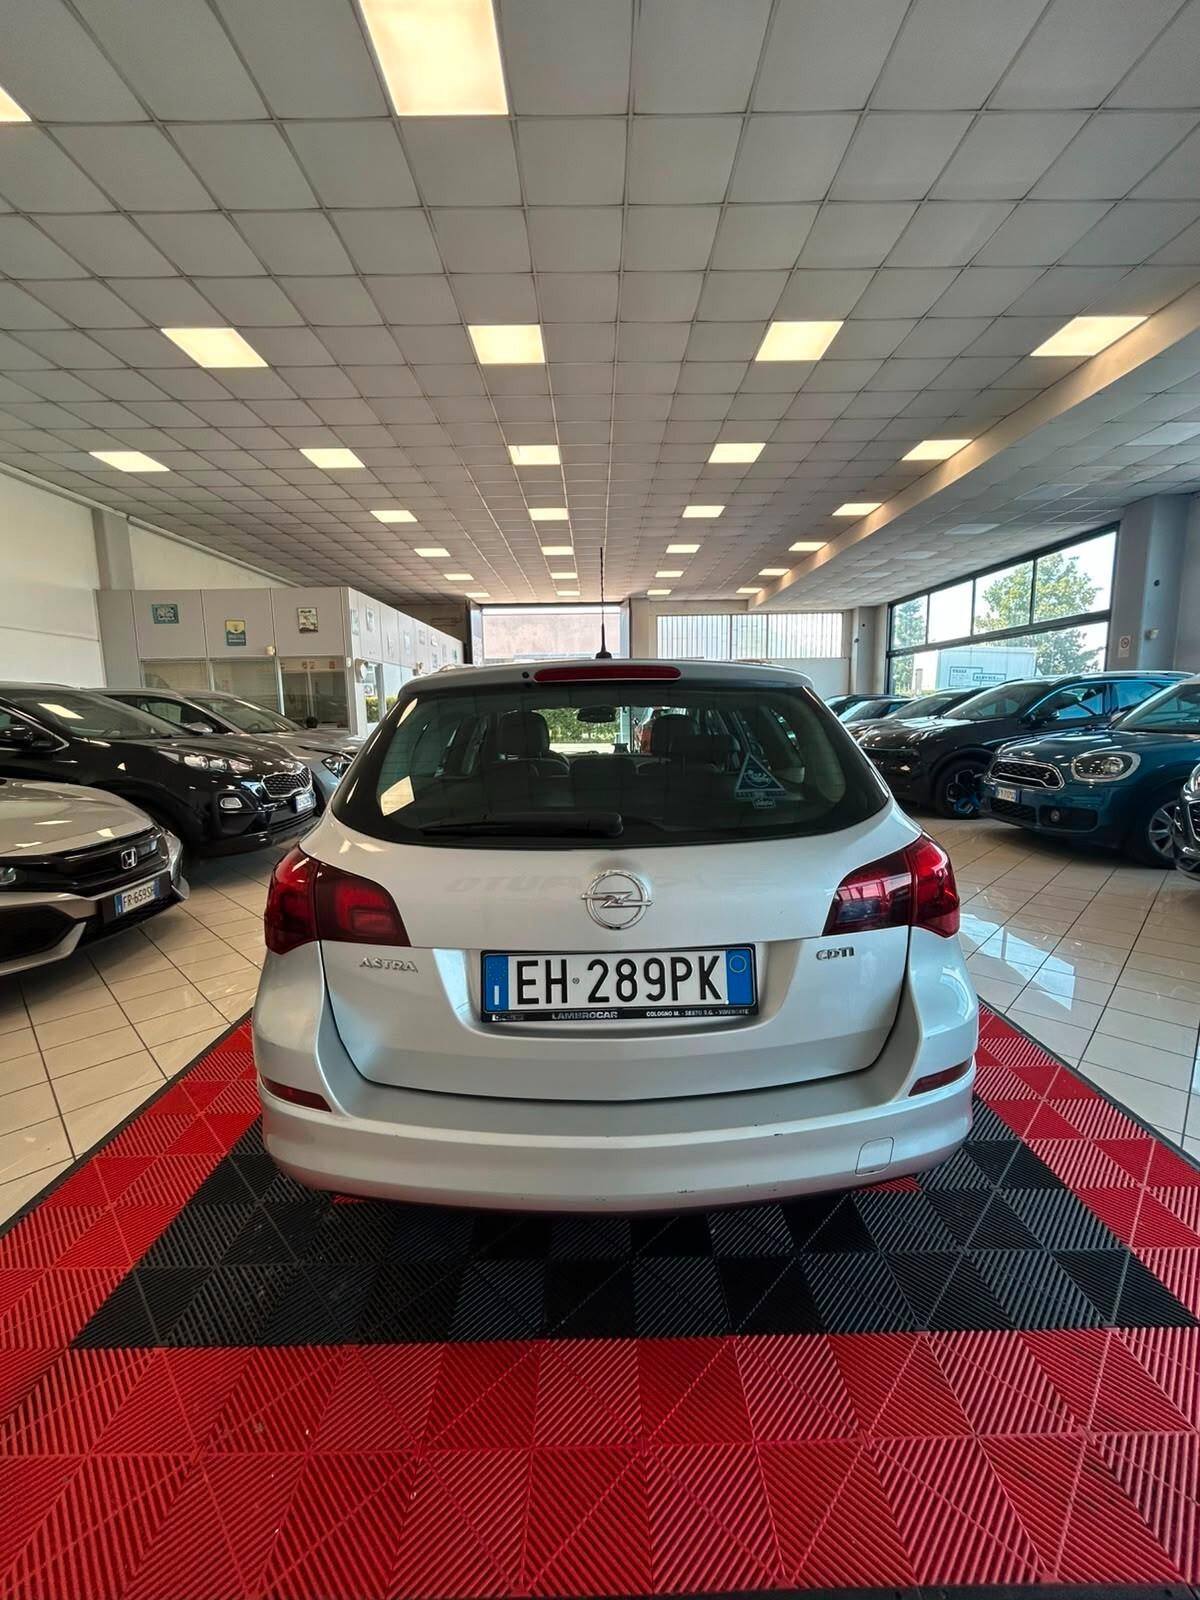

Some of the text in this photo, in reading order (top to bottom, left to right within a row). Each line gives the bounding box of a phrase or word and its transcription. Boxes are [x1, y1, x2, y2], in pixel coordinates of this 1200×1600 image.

[816, 946, 854, 960] CDTI
[359, 956, 418, 973] ASTRA
[516, 955, 723, 1005] EH 289PK
[551, 1011, 618, 1020] LAMBROCAR
